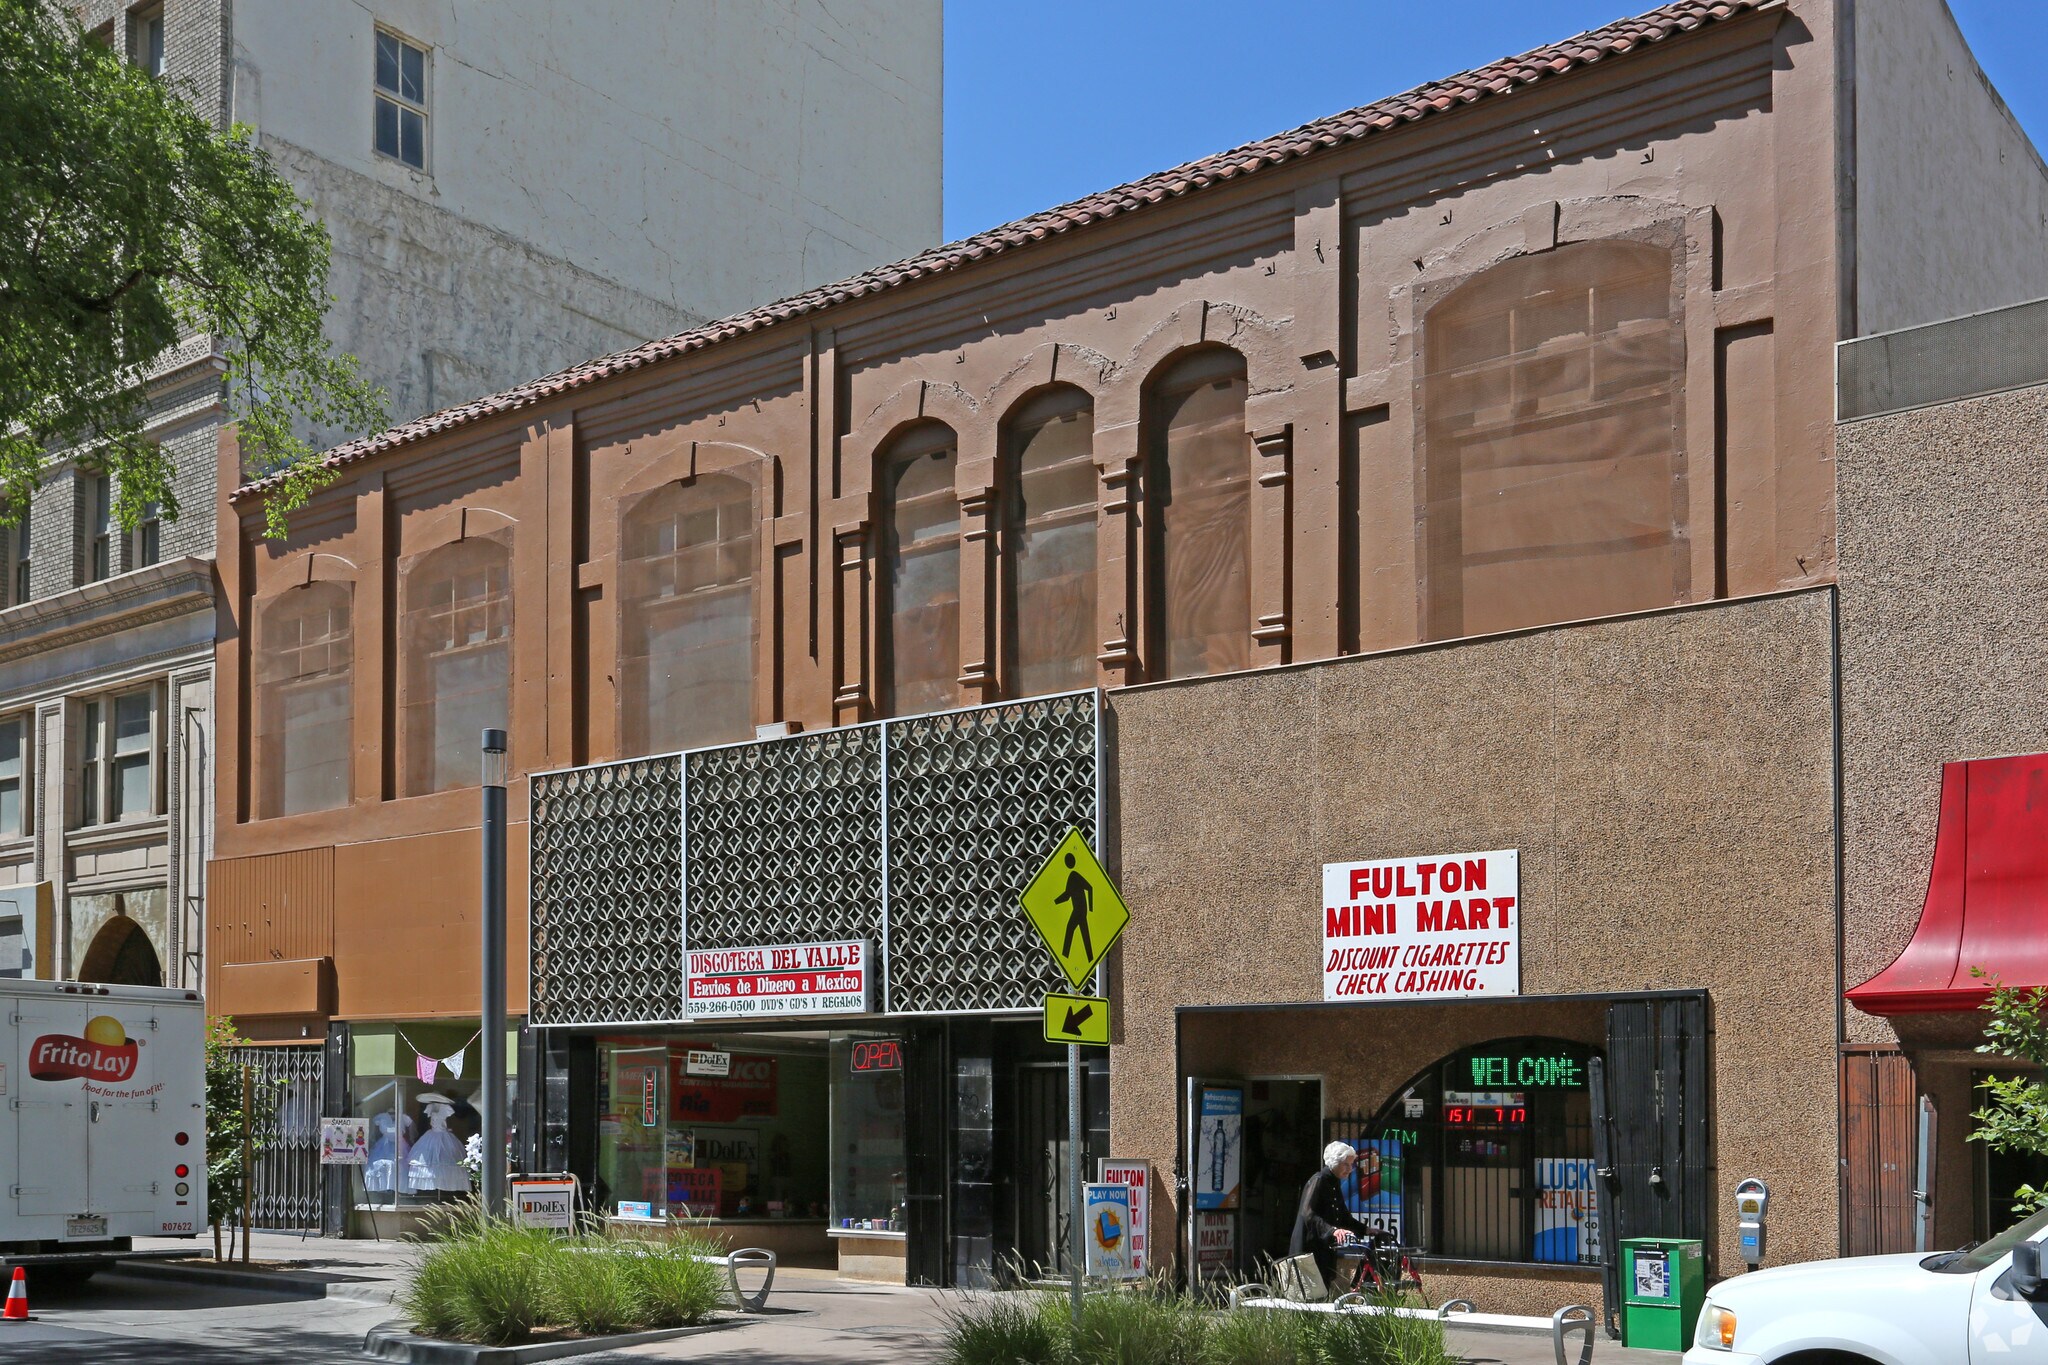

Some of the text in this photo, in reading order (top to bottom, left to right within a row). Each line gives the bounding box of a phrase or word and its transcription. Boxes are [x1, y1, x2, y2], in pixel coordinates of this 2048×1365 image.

[1349, 858, 1487, 900] FULTON
[1326, 896, 1516, 938] MINI MART
[690, 944, 860, 975] DISCOTECA DEL VALLE
[1325, 941, 1511, 973] DISCOUNT CIGARETTES
[692, 972, 859, 997] Envios de Dinero a Mexico
[1335, 968, 1485, 996] CHECK CASHING.
[687, 999, 756, 1014] 559-266-0500
[811, 997, 818, 1009] Y
[822, 995, 862, 1009] REGALOS
[699, 1053, 728, 1066] DolEx
[1471, 1057, 1582, 1086] WELCOME
[81, 1082, 101, 1095] food
[102, 1088, 114, 1099] for
[116, 1090, 130, 1098] the
[131, 1089, 145, 1099] fun
[645, 1069, 655, 1124] OPEN
[1512, 1109, 1526, 1122] 17
[709, 1139, 757, 1160] DolEx
[1105, 1169, 1144, 1187] FULTON
[1088, 1190, 1108, 1200] PLAY
[1109, 1190, 1127, 1200] NOW
[1538, 1190, 1597, 1211] RETAILE
[533, 1200, 566, 1213] DolEx
[1204, 1214, 1227, 1227] MINI
[1200, 1229, 1229, 1247] MART
